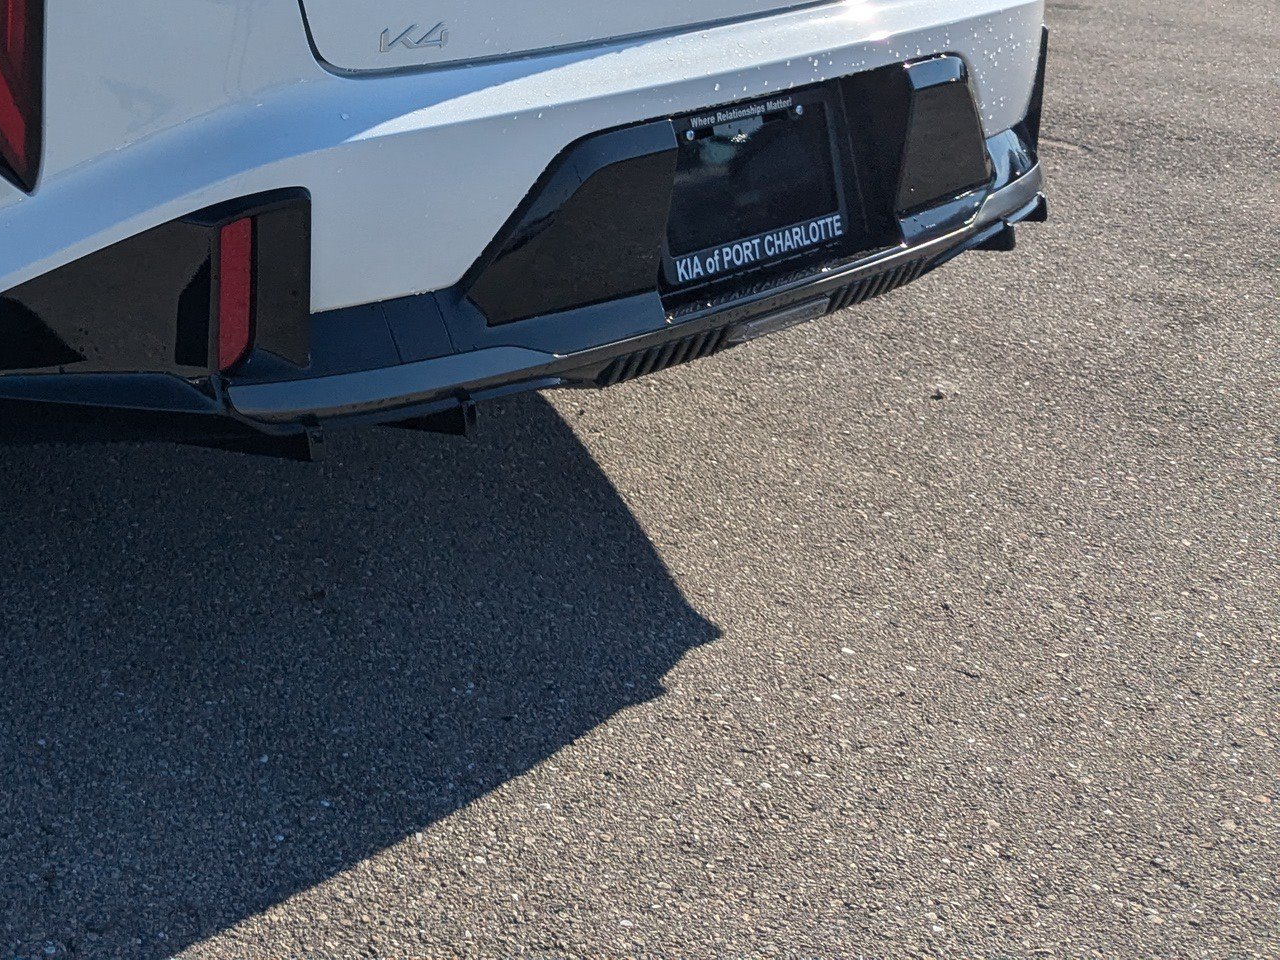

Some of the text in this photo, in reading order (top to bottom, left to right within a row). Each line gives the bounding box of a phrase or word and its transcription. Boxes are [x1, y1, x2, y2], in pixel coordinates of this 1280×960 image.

[379, 21, 449, 53] K4
[690, 96, 793, 128] Where Relationships Matter!
[675, 214, 843, 282] KIA of PORT CHARLOTTE
